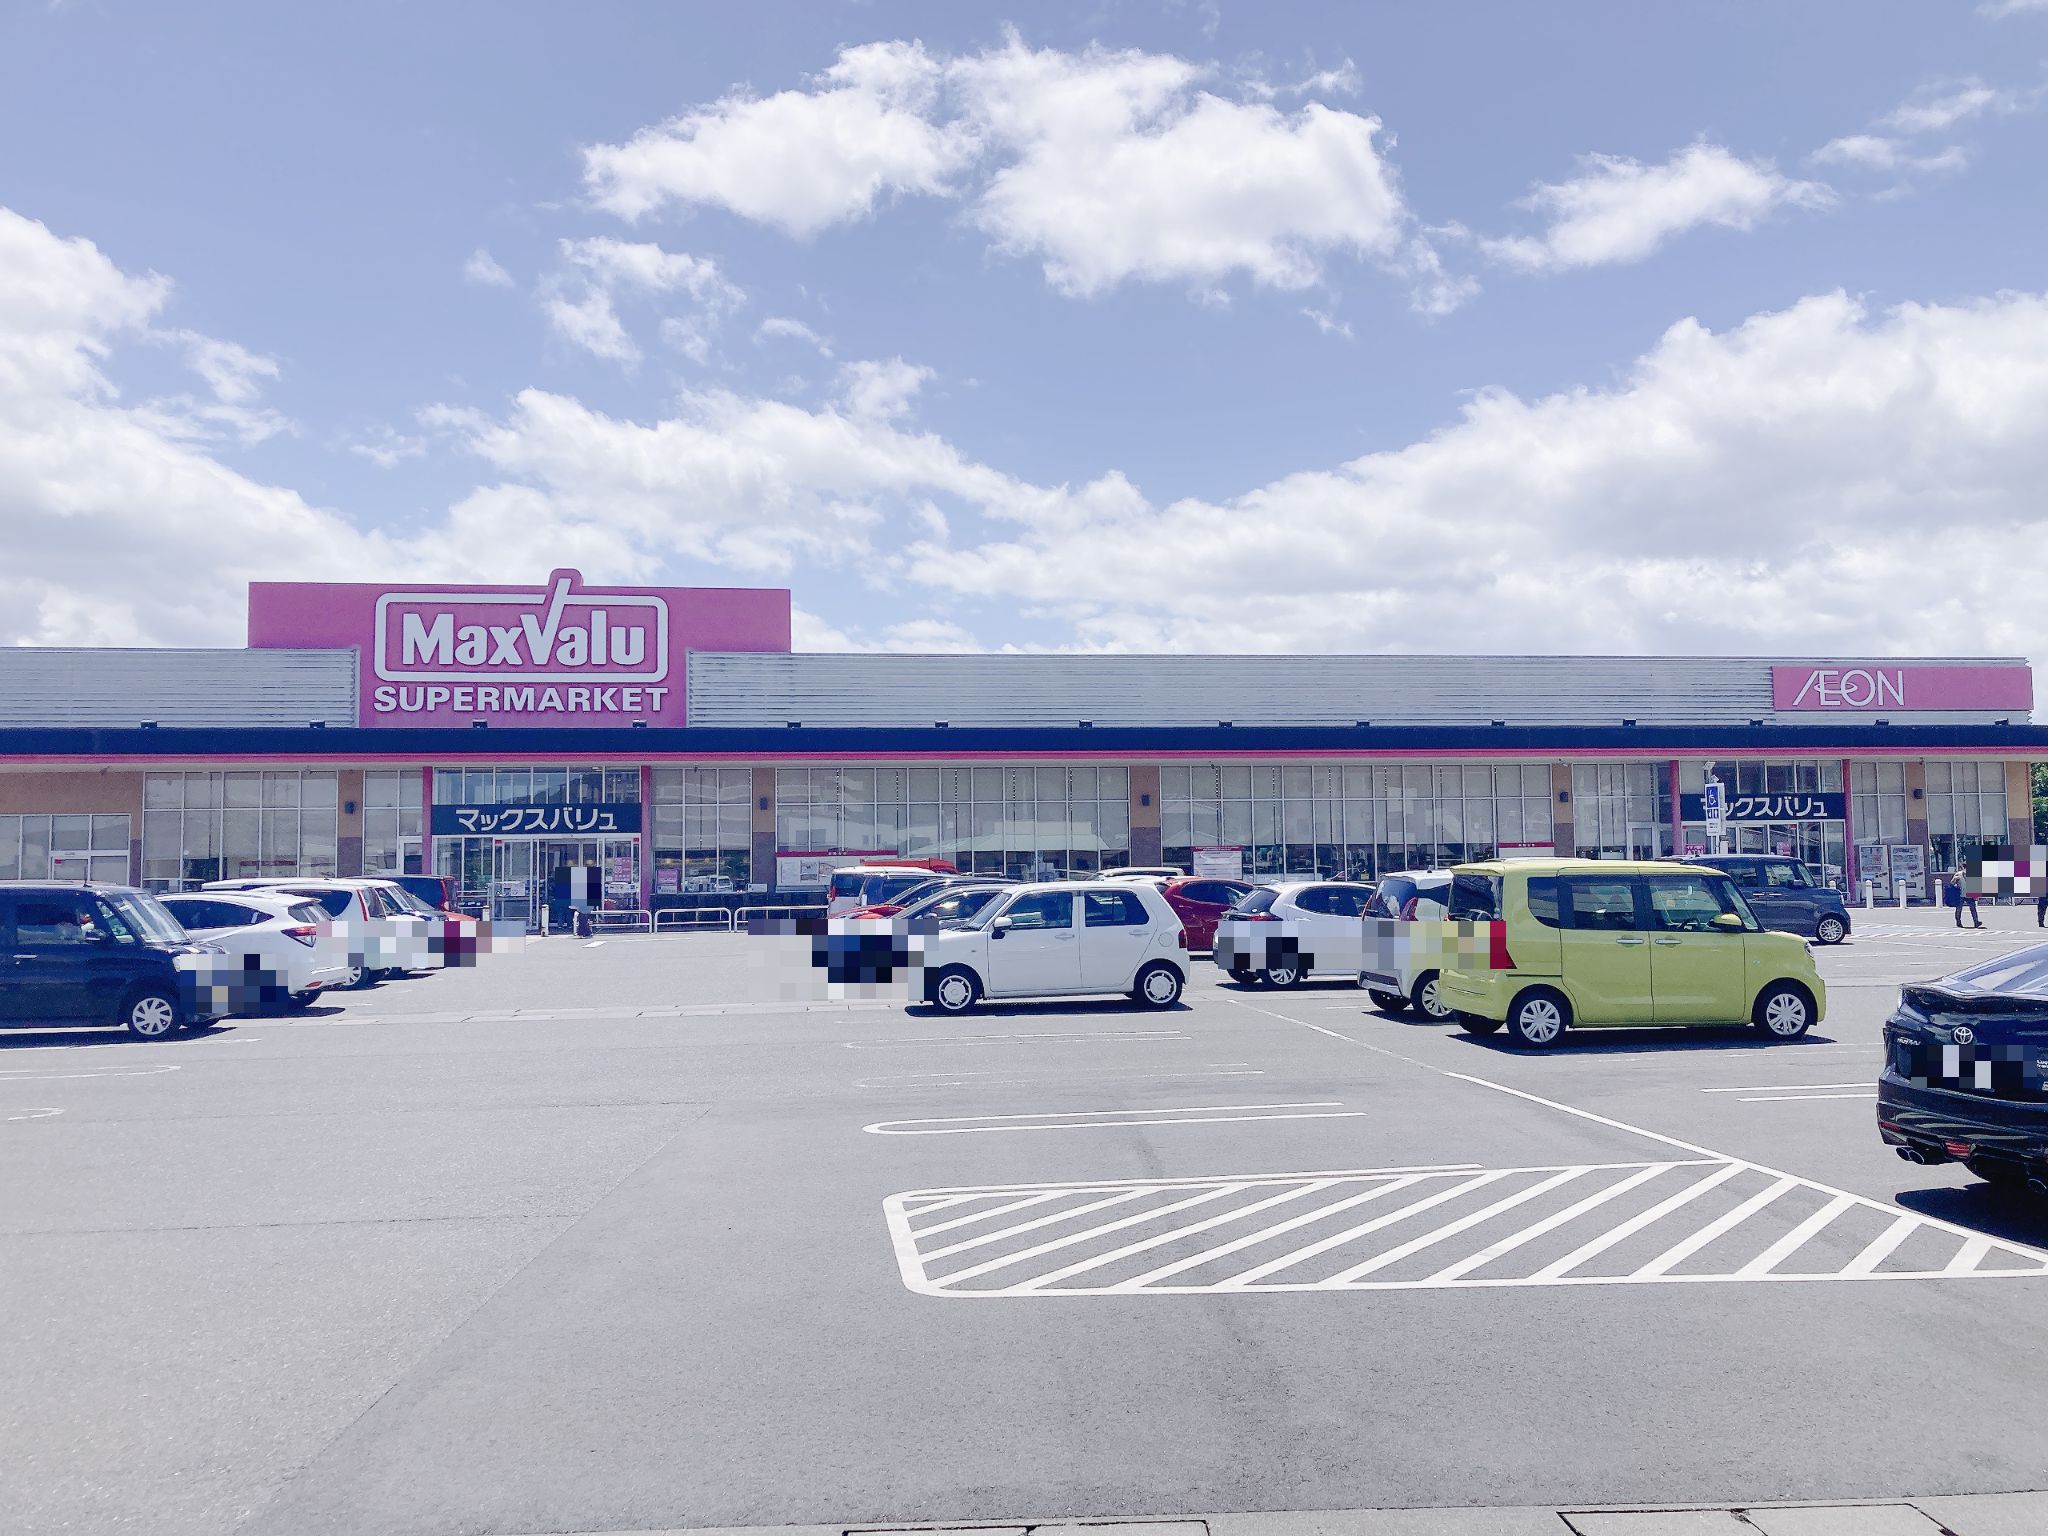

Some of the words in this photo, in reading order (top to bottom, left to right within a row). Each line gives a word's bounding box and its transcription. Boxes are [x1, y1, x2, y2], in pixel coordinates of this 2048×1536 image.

[402, 578, 645, 666] MaxValu
[373, 686, 669, 712] SUPERMARKET
[455, 807, 618, 832] マックスバリュ
[1700, 796, 1828, 818] ックスバリュ
